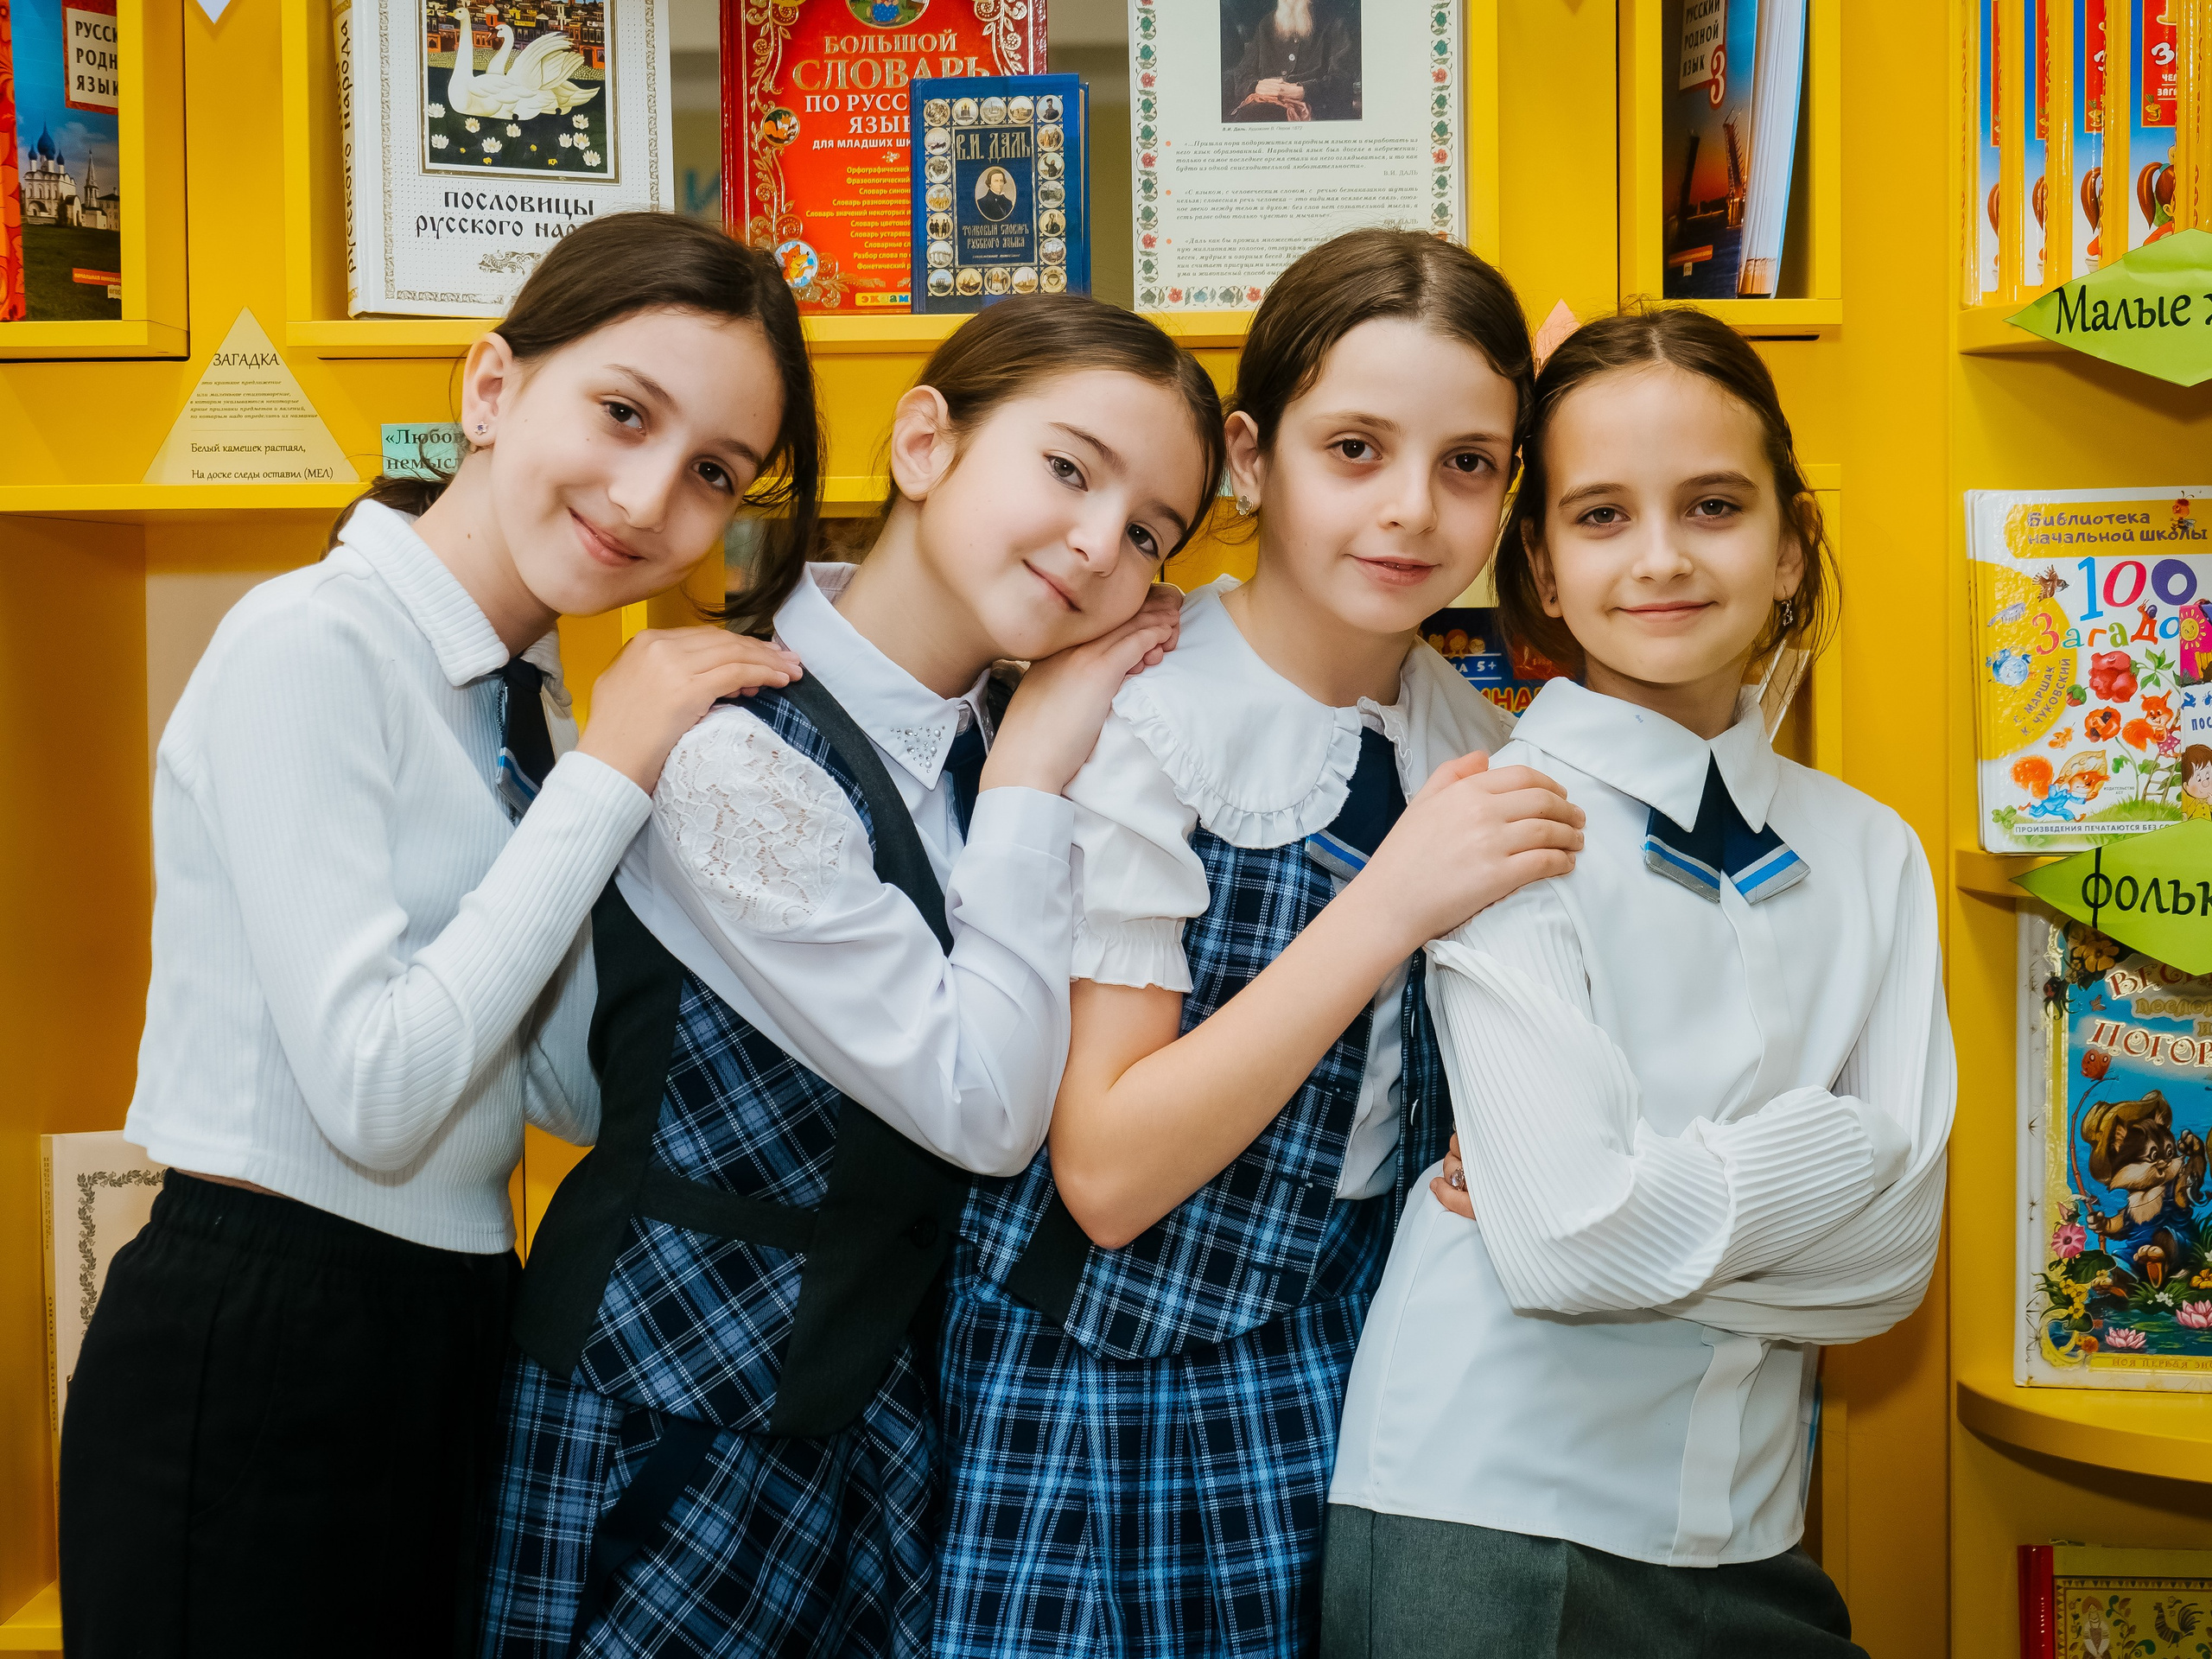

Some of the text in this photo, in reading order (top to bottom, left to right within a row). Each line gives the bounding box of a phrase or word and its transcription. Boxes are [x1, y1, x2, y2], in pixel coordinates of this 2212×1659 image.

[824, 29, 958, 54] БОЛЬШОЙ
[1684, 19, 1719, 51] РОДНОЙ
[76, 48, 118, 71] РОДН
[792, 56, 990, 91] СЛОВАРЬ
[1710, 51, 1726, 104] 3
[805, 93, 910, 112] ПО РУСС
[813, 140, 835, 150] ДЛЯ
[837, 139, 893, 149] МЛАДШИХ
[956, 131, 1031, 164] В.И. ДАЛЬ
[846, 166, 910, 175] Орфографический
[846, 177, 911, 186] Фразеологический
[859, 188, 888, 196] Словарь
[832, 199, 861, 207] Словарь
[416, 214, 523, 239] русского
[967, 238, 1000, 250] РУССКОГО
[2055, 284, 2191, 334] Малые
[213, 353, 280, 370] ЗАГАДКА
[191, 442, 307, 454] Белый камешек растаял,
[191, 467, 334, 481] На доске следы оставил (МЕЛ)
[2027, 512, 2151, 527] Библиотека
[2028, 529, 2209, 544] начальной школы
[2077, 556, 2198, 621] 100
[2024, 665, 2056, 714] МАРШАК
[2032, 658, 2071, 723] ЧУКОВСКИЙ
[1481, 687, 1541, 713] НА
[2015, 824, 2082, 834] ПРОИЗВЕДЕНИЯ
[2084, 823, 2140, 832] ПЕЧАТАЮТСЯ
